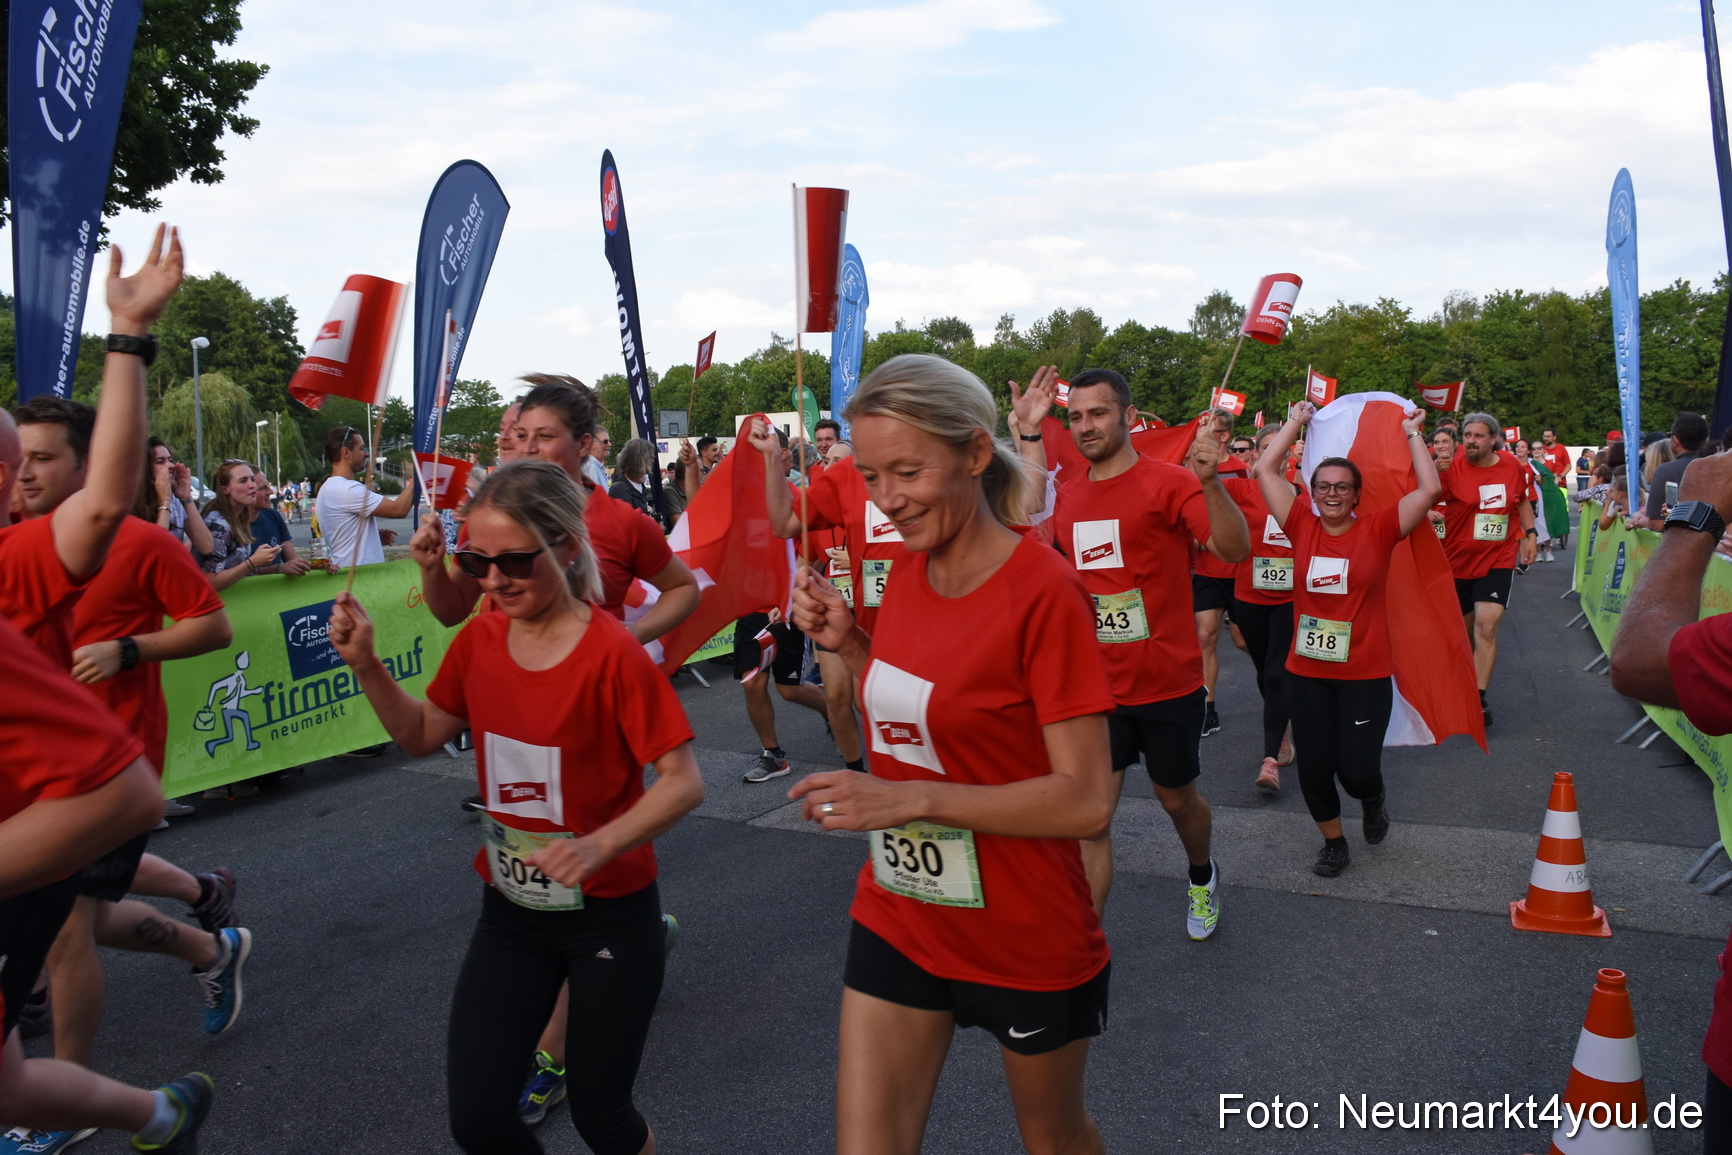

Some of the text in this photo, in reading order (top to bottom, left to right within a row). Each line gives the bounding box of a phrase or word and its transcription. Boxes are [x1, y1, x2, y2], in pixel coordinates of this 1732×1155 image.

[448, 193, 481, 273] Fischer
[460, 207, 486, 272] AUTOMOBILE
[53, 219, 91, 400] her-automobile.de
[1482, 523, 1503, 534] 479
[1261, 569, 1287, 581] 492
[1306, 631, 1337, 650] 518
[270, 703, 346, 741] neumarkt
[510, 786, 537, 798] DEHN
[498, 850, 552, 890] 504
[883, 831, 944, 877] 530
